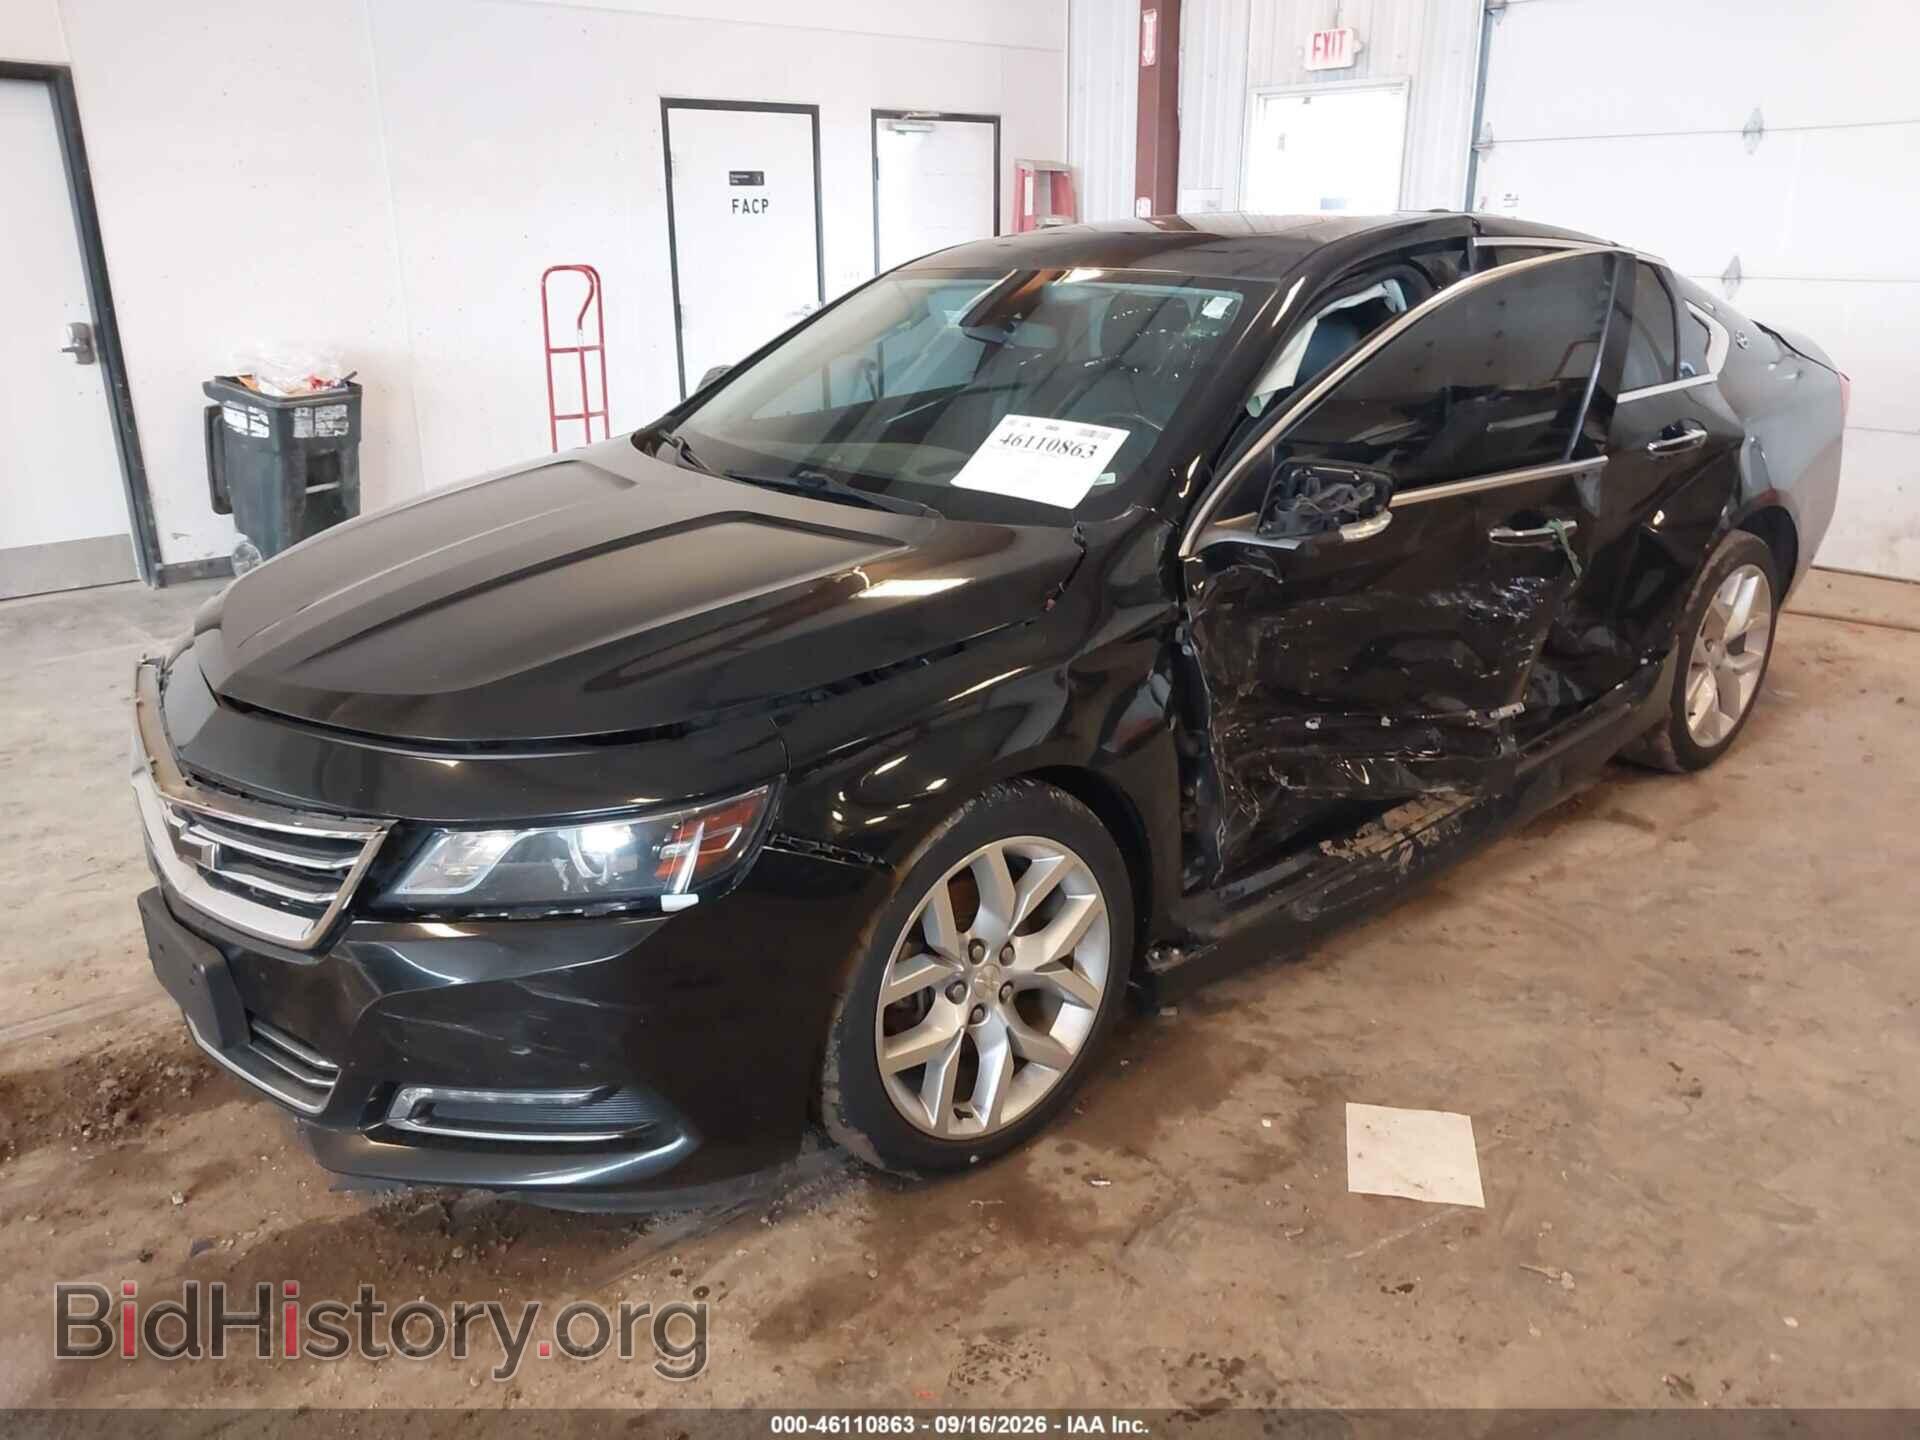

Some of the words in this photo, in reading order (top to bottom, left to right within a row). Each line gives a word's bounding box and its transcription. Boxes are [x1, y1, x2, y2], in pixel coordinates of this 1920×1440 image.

[1312, 31, 1346, 62] EXIT
[731, 198, 769, 215] FACP
[999, 432, 1098, 459] 46110863
